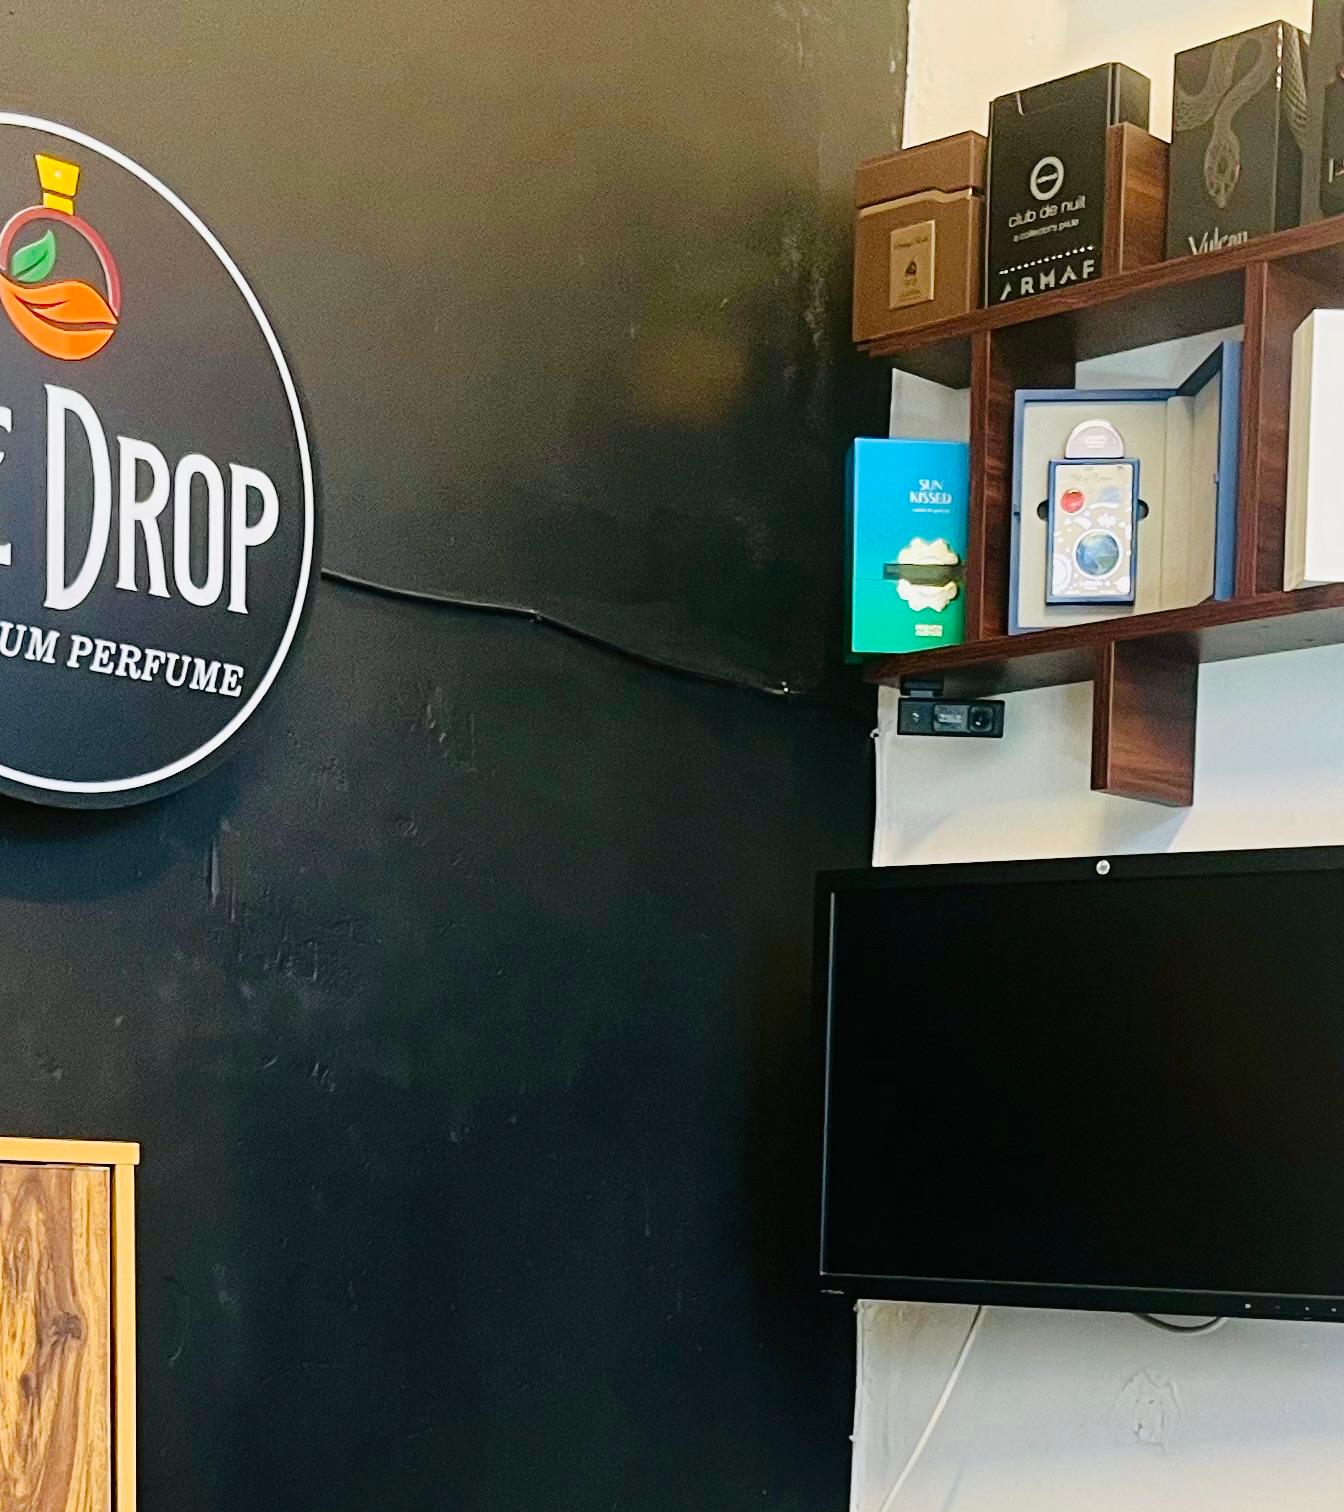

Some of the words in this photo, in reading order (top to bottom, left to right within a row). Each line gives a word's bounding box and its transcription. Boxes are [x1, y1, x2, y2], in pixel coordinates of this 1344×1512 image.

[1008, 209, 1037, 228] club
[1000, 259, 1095, 301] ARMAF
[43, 383, 280, 614] DROP
[67, 633, 244, 698] PERFUME
